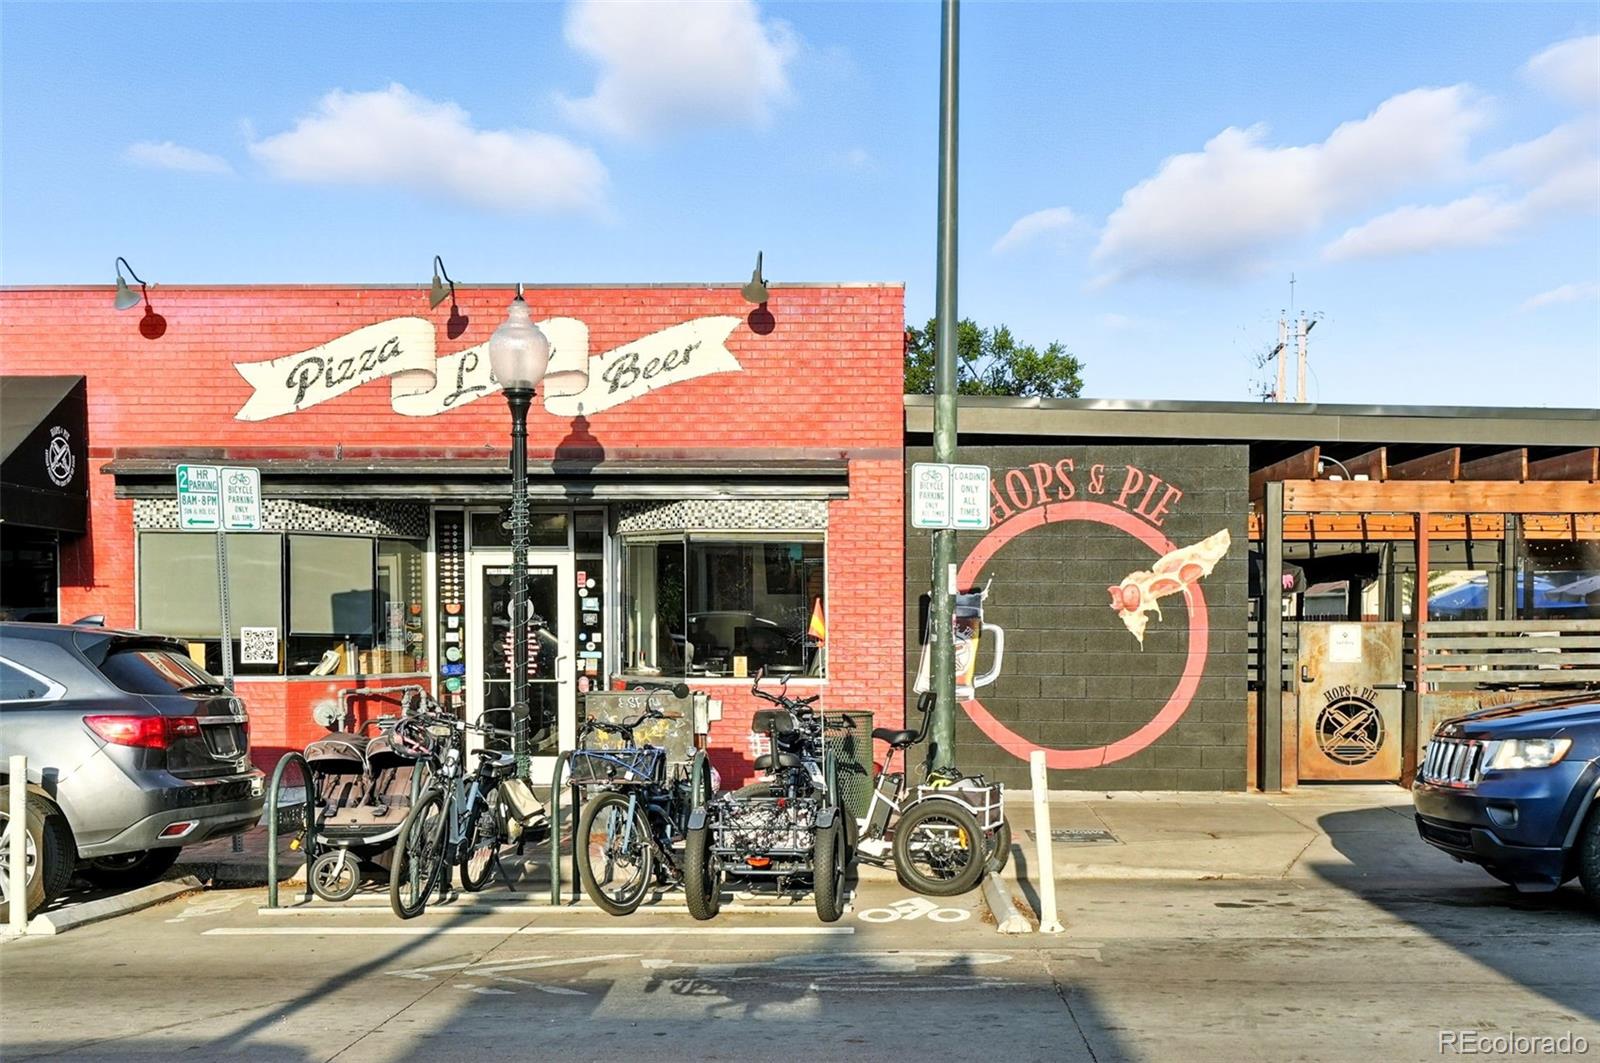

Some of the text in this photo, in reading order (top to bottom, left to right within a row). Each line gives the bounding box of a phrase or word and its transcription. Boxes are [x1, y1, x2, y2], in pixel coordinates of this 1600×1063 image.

[285, 335, 404, 405] Pizza
[602, 340, 702, 395] Beer
[179, 469, 208, 486] 2 HR
[955, 472, 985, 481] LOADING
[189, 480, 217, 491] PARKING
[228, 485, 253, 495] BICYCLE
[919, 482, 944, 491] BICYCLE
[961, 485, 979, 494] ONLY
[228, 495, 254, 504] PARKING
[919, 491, 944, 500] PARKING
[1088, 464, 1105, 495] &
[1113, 465, 1184, 527] PIE
[964, 497, 976, 505] ALL
[960, 507, 980, 517] TIMES
[1323, 684, 1378, 703] HOPS & PIE
